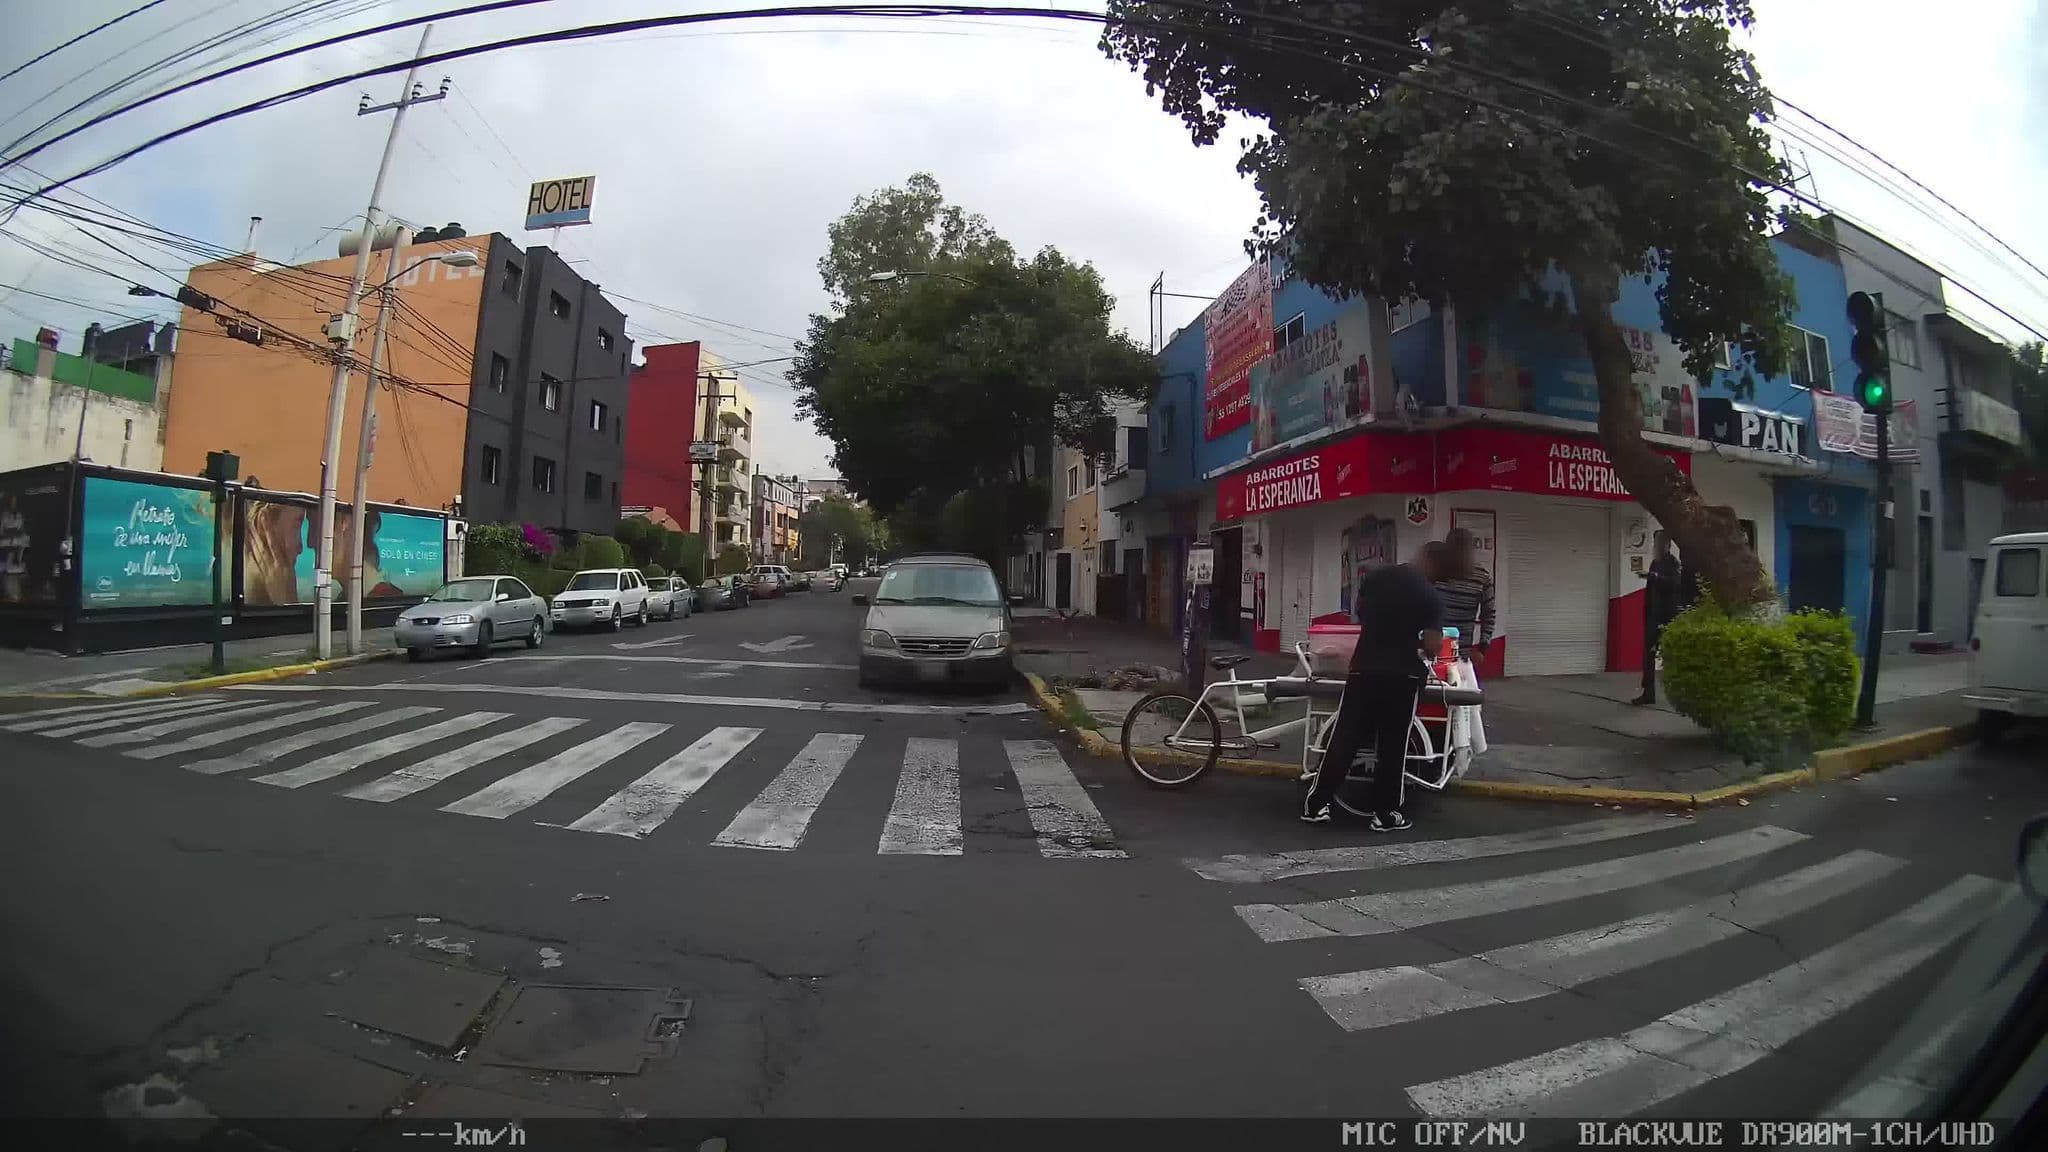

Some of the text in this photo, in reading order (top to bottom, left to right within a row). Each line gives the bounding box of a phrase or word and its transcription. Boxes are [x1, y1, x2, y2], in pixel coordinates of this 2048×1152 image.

[528, 178, 590, 215] HOTEL
[1741, 412, 1799, 454] PAN
[1246, 455, 1320, 487] ABARROTES
[1549, 443, 1611, 464] ABARR
[1246, 488, 1257, 512] LA
[1259, 472, 1322, 509] ESPERANZA
[1549, 461, 1565, 489] LA
[1569, 463, 1631, 495] ESPERAN
[153, 525, 188, 563] mujer
[404, 551, 414, 560] EN
